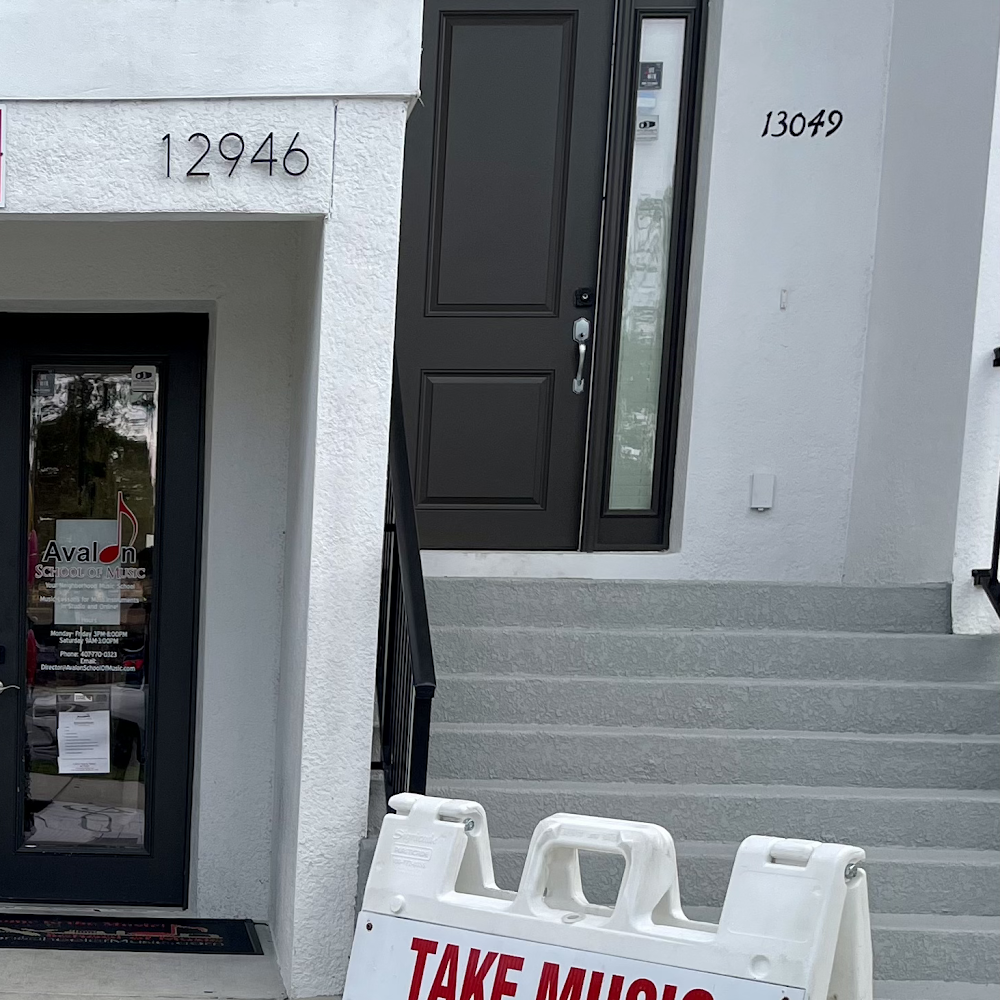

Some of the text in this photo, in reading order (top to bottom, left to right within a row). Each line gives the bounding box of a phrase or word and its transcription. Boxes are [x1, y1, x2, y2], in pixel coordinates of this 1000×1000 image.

[761, 109, 843, 137] 13049
[162, 132, 309, 178] 12946
[35, 564, 146, 580] SCHOOL OF MUSIC
